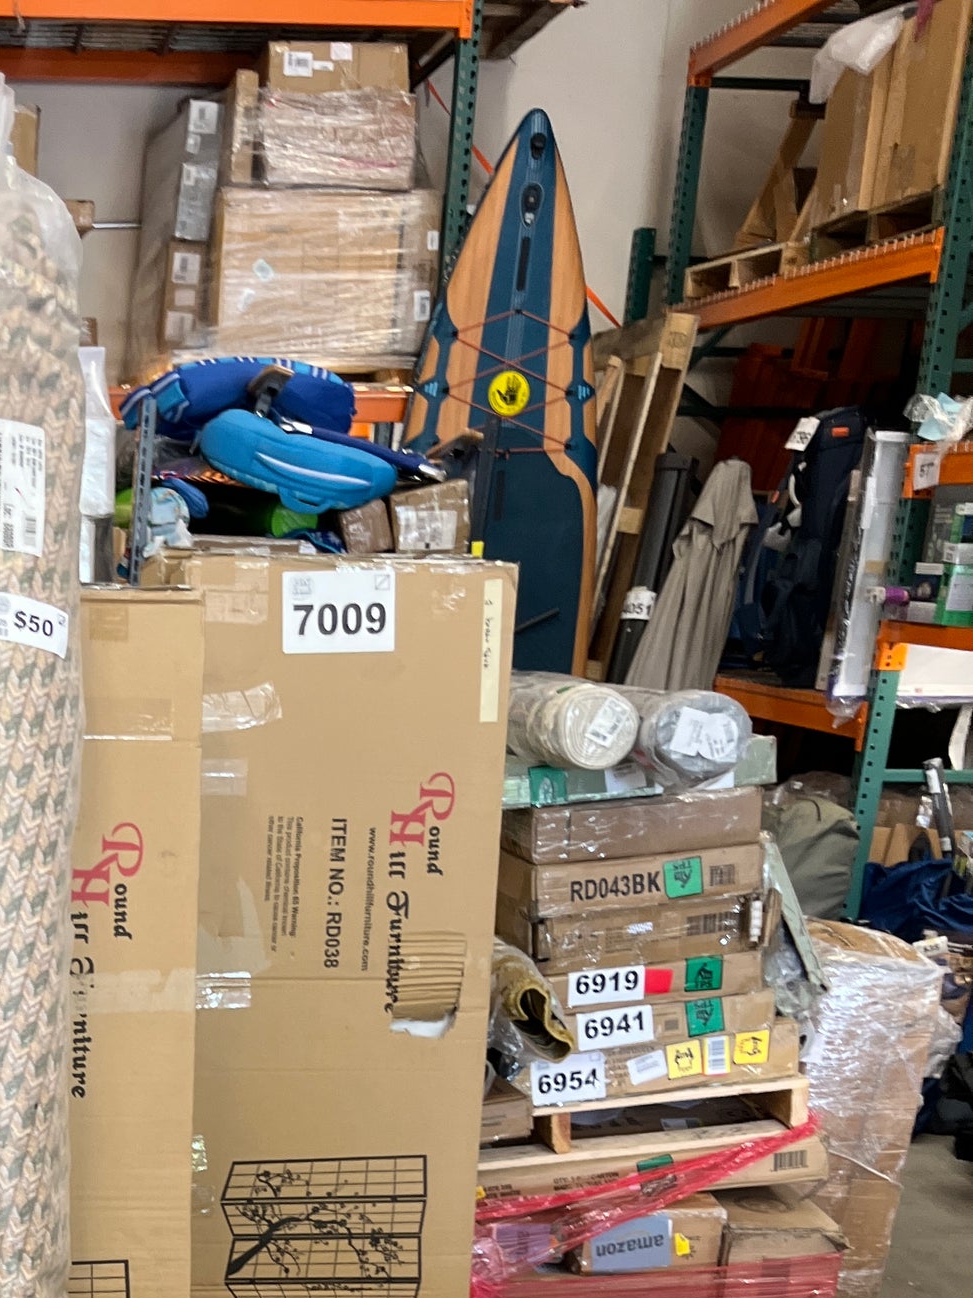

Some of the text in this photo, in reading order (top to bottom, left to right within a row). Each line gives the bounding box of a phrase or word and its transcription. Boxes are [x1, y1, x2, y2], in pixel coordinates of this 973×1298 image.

[13, 610, 54, 637] $50
[293, 602, 387, 637] 7009
[295, 817, 304, 851] California
[419, 771, 456, 875] Round
[388, 811, 425, 879] Hill
[102, 822, 144, 940] Round
[292, 853, 301, 894] Proposition
[570, 870, 662, 902] RD043BK
[323, 818, 347, 968] ITEM NO.: RD038
[361, 827, 377, 971] www.roundhillfurniture.com
[576, 970, 639, 995] 6919
[584, 1011, 645, 1040] 6941
[538, 1068, 599, 1095] 6954
[595, 1234, 665, 1258] amazon
